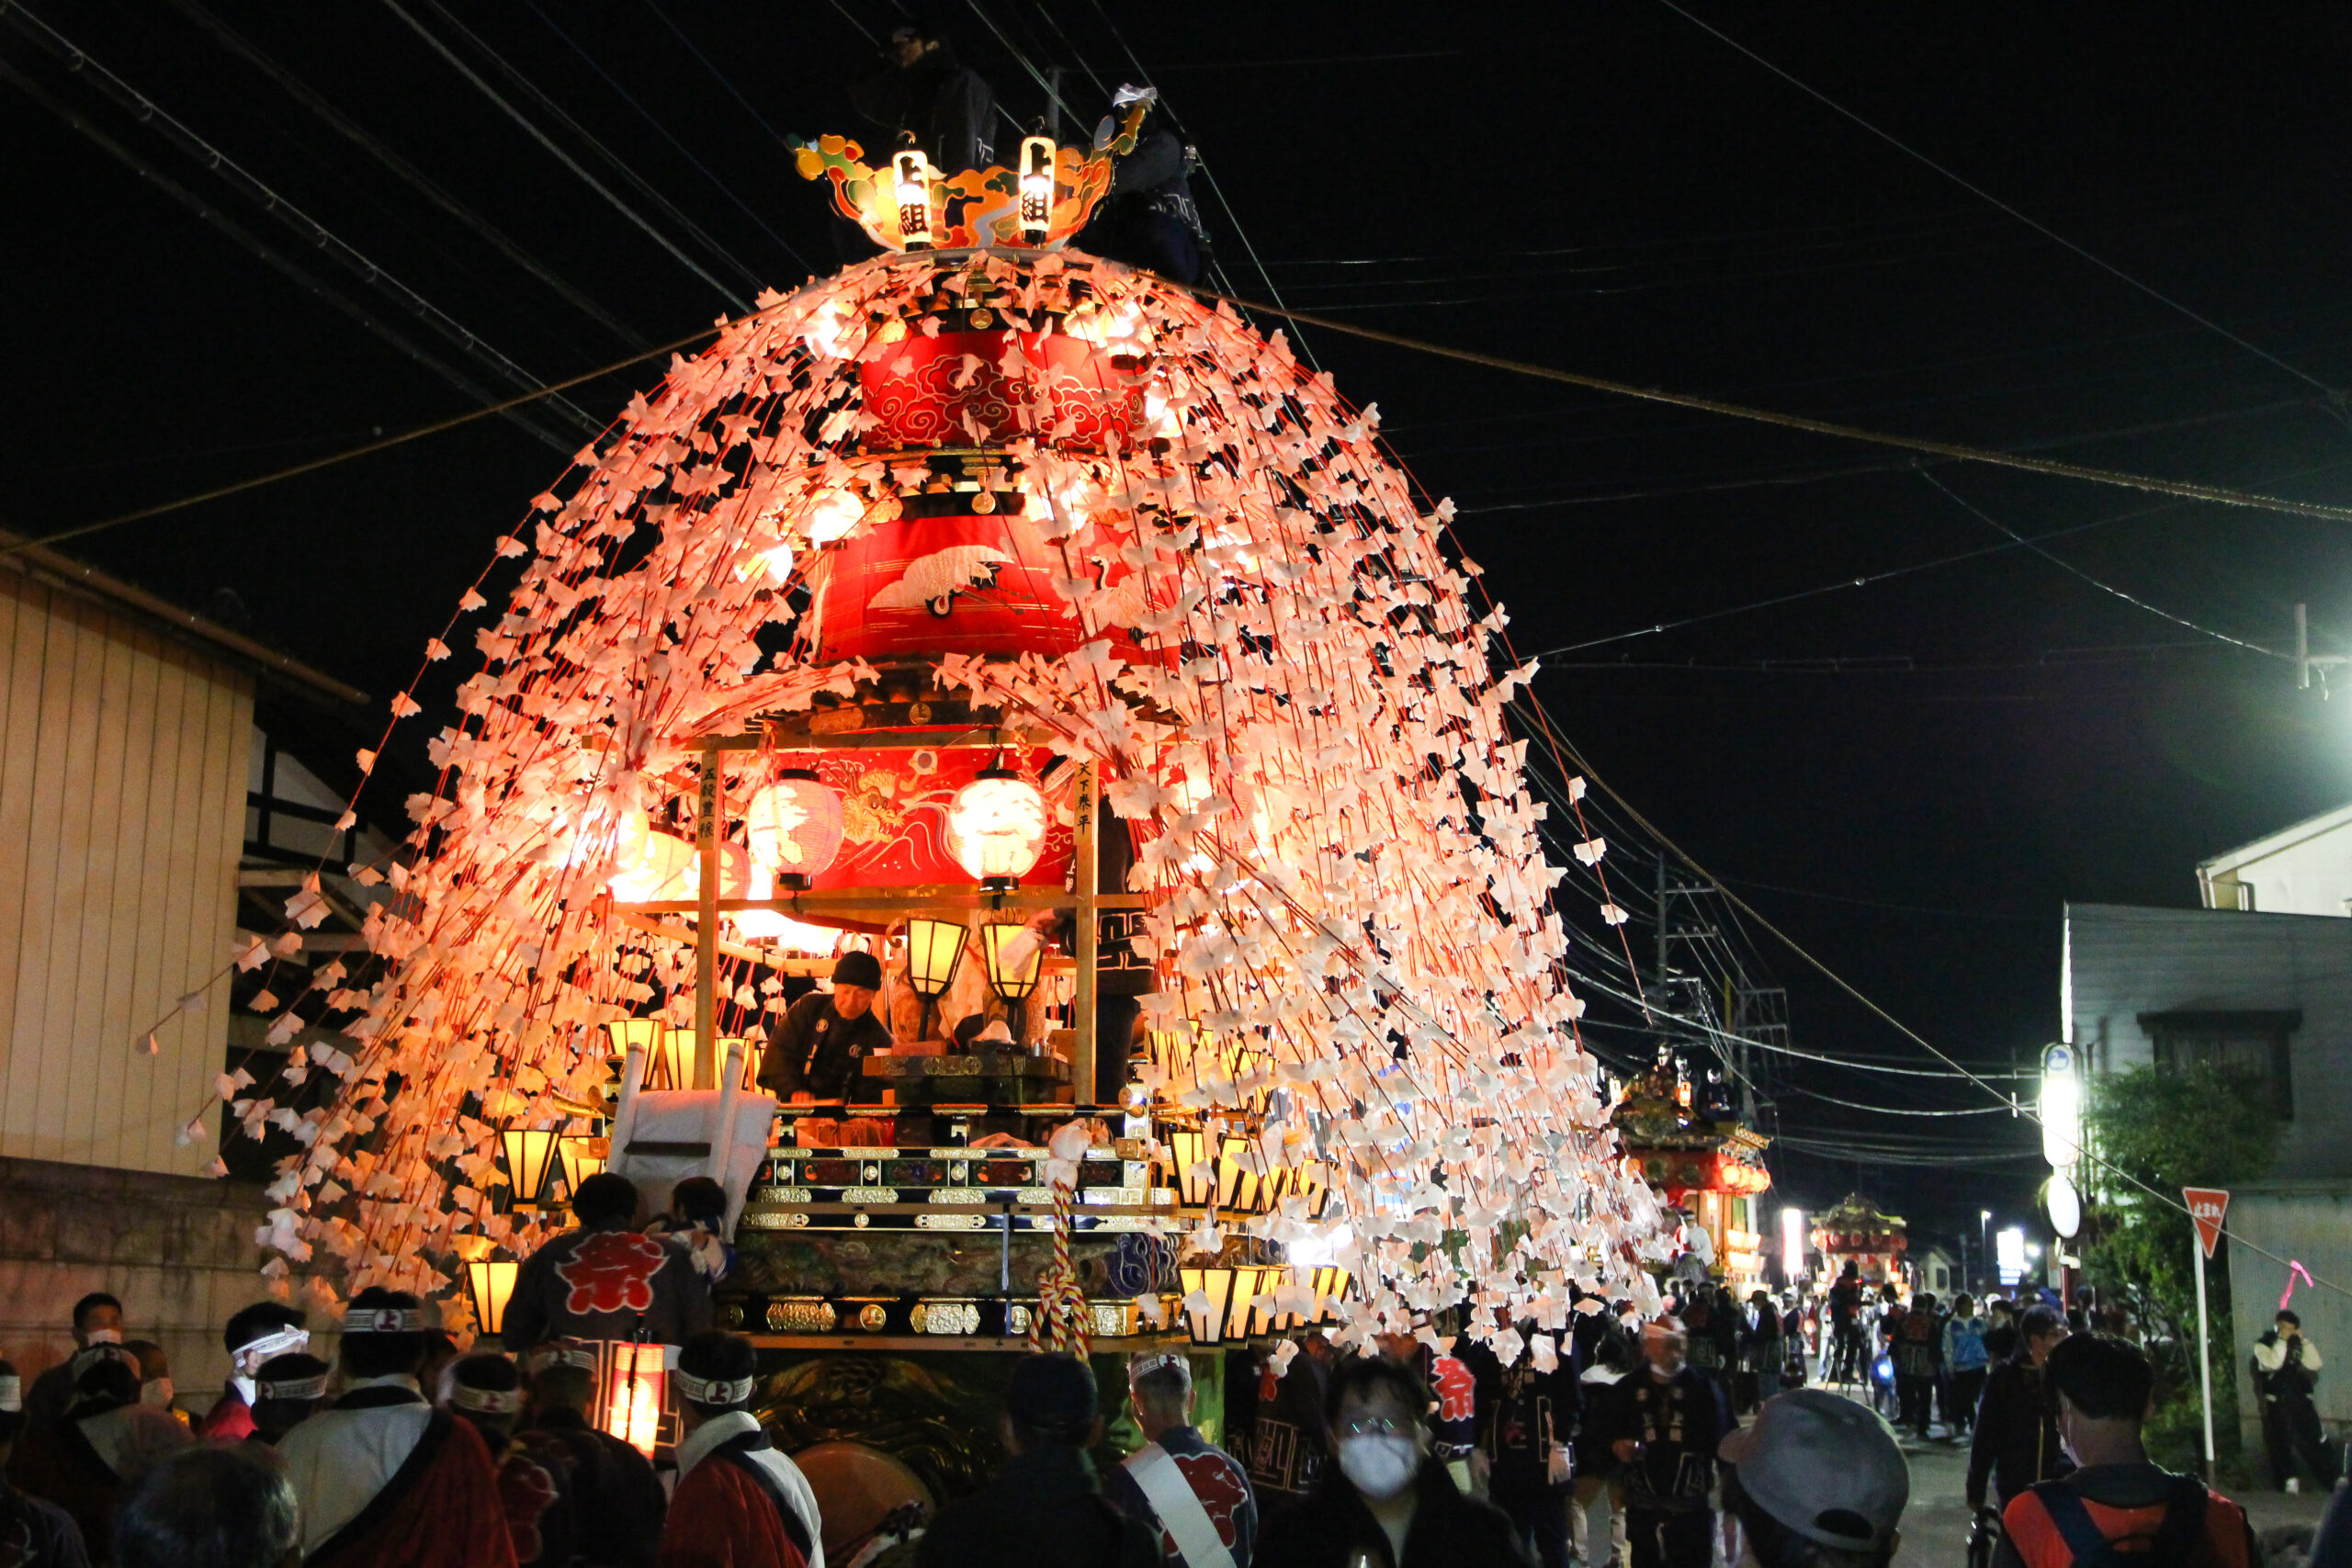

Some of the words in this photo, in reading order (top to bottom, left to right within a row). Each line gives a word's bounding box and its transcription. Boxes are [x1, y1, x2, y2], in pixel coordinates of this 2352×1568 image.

[899, 155, 930, 236] 上組
[1022, 142, 1052, 225] 上組
[1077, 761, 1092, 836] 天下泰平
[2193, 1201, 2222, 1218] 止まれ
[379, 1311, 398, 1330] 上
[708, 1382, 728, 1403] 上
